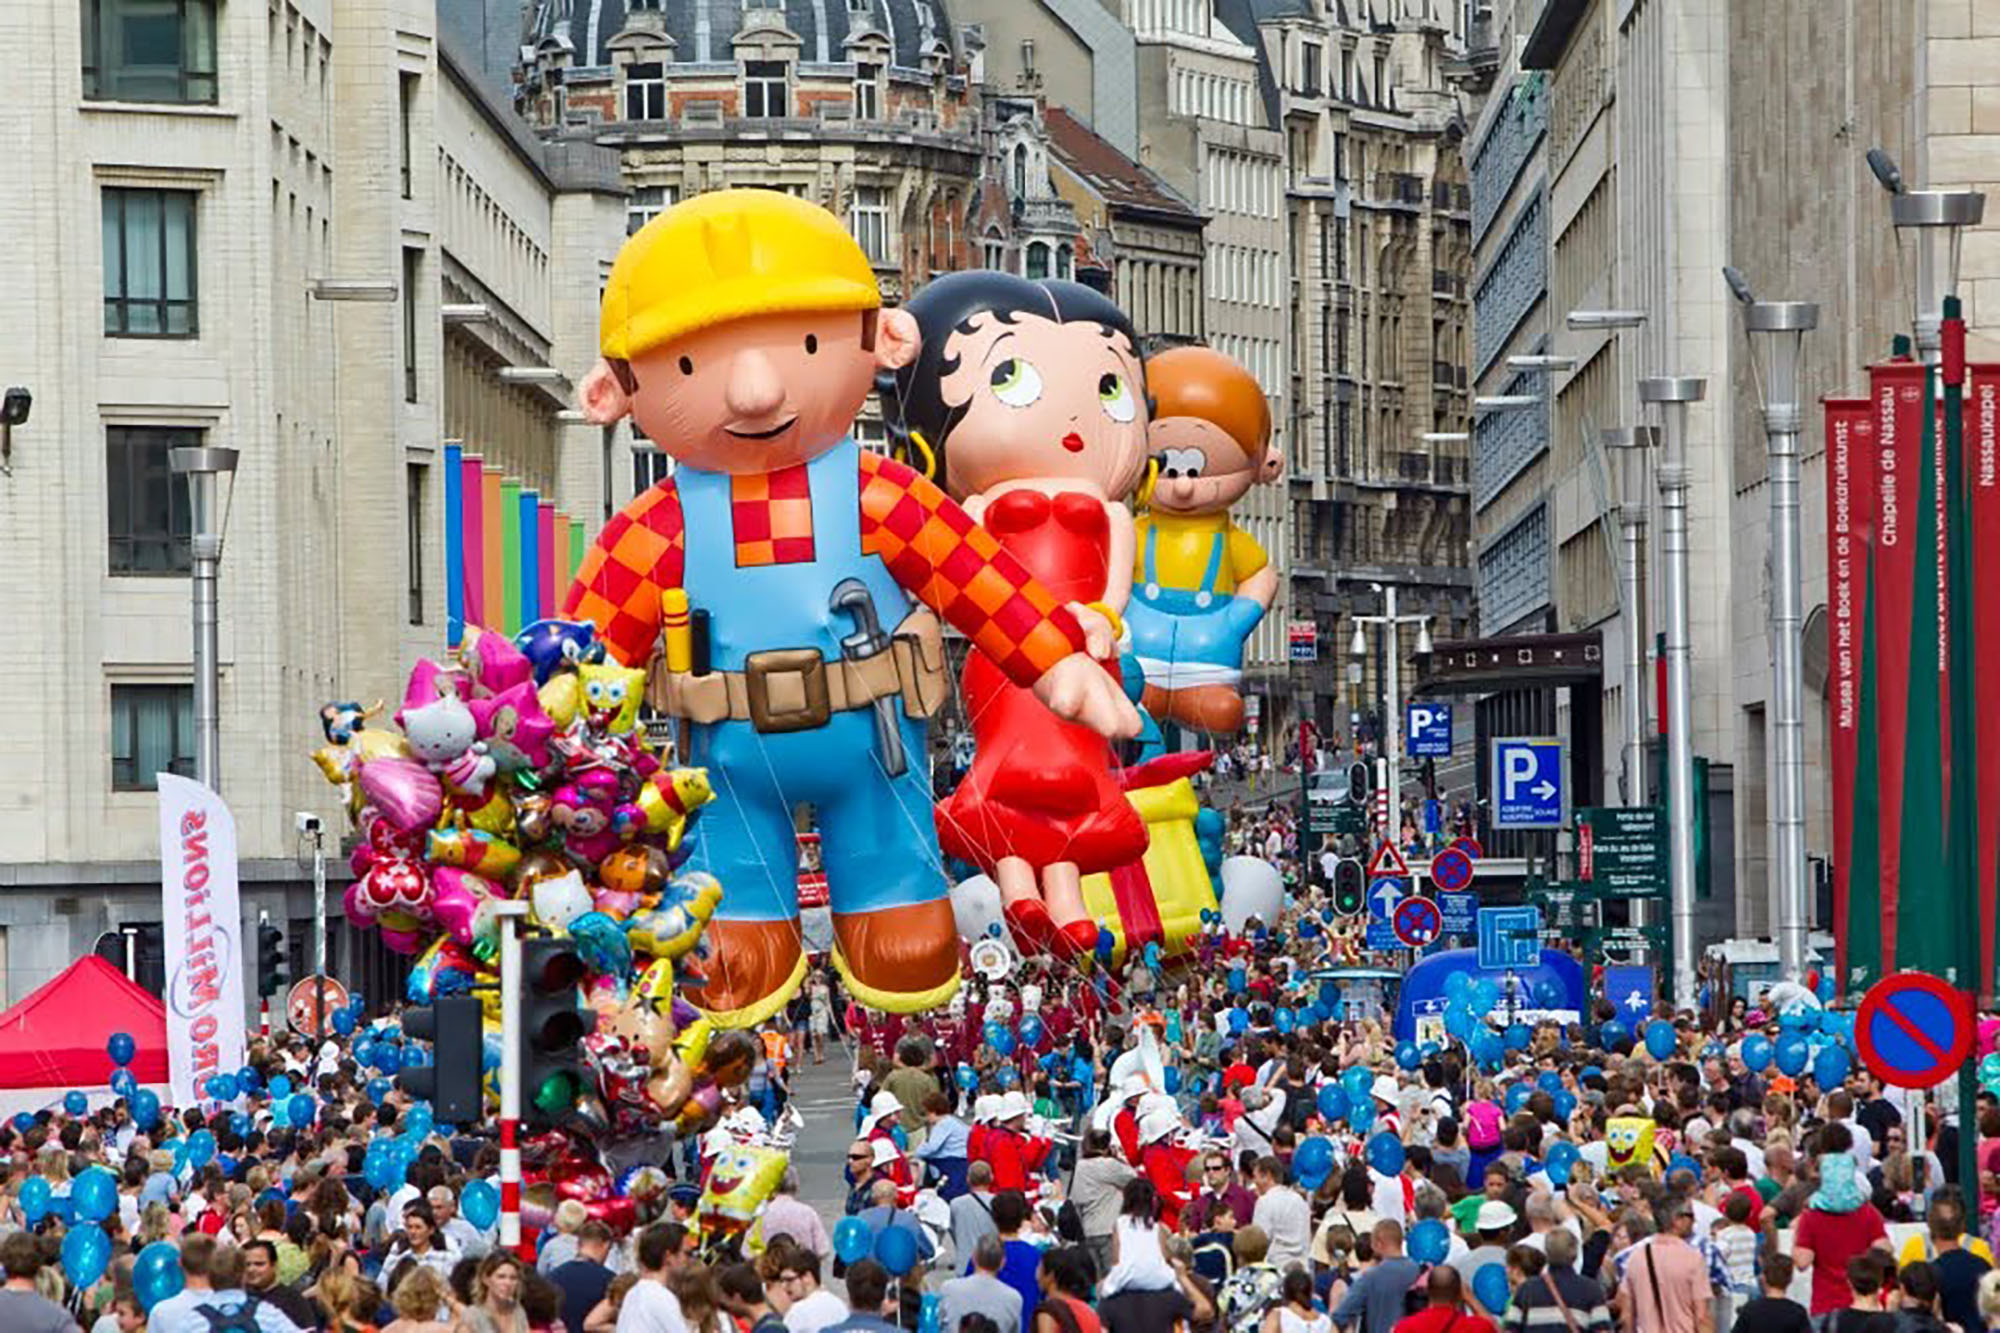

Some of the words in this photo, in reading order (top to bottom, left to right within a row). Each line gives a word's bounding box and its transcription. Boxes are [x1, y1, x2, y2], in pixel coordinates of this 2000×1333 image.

[1880, 386, 1895, 445] Nassau
[1980, 385, 1994, 486] Nassaukapel
[1835, 420, 1849, 532] Boekdrukkunst
[1880, 449, 1896, 471] de
[1881, 474, 1897, 546] Chapelle
[1836, 536, 1849, 555] de
[1838, 559, 1850, 577] en
[1836, 578, 1851, 618] Boek
[1837, 621, 1851, 648] het
[1839, 651, 1852, 677] van
[1411, 709, 1433, 738] P
[1839, 679, 1852, 729] Musea
[1504, 748, 1538, 800] P
